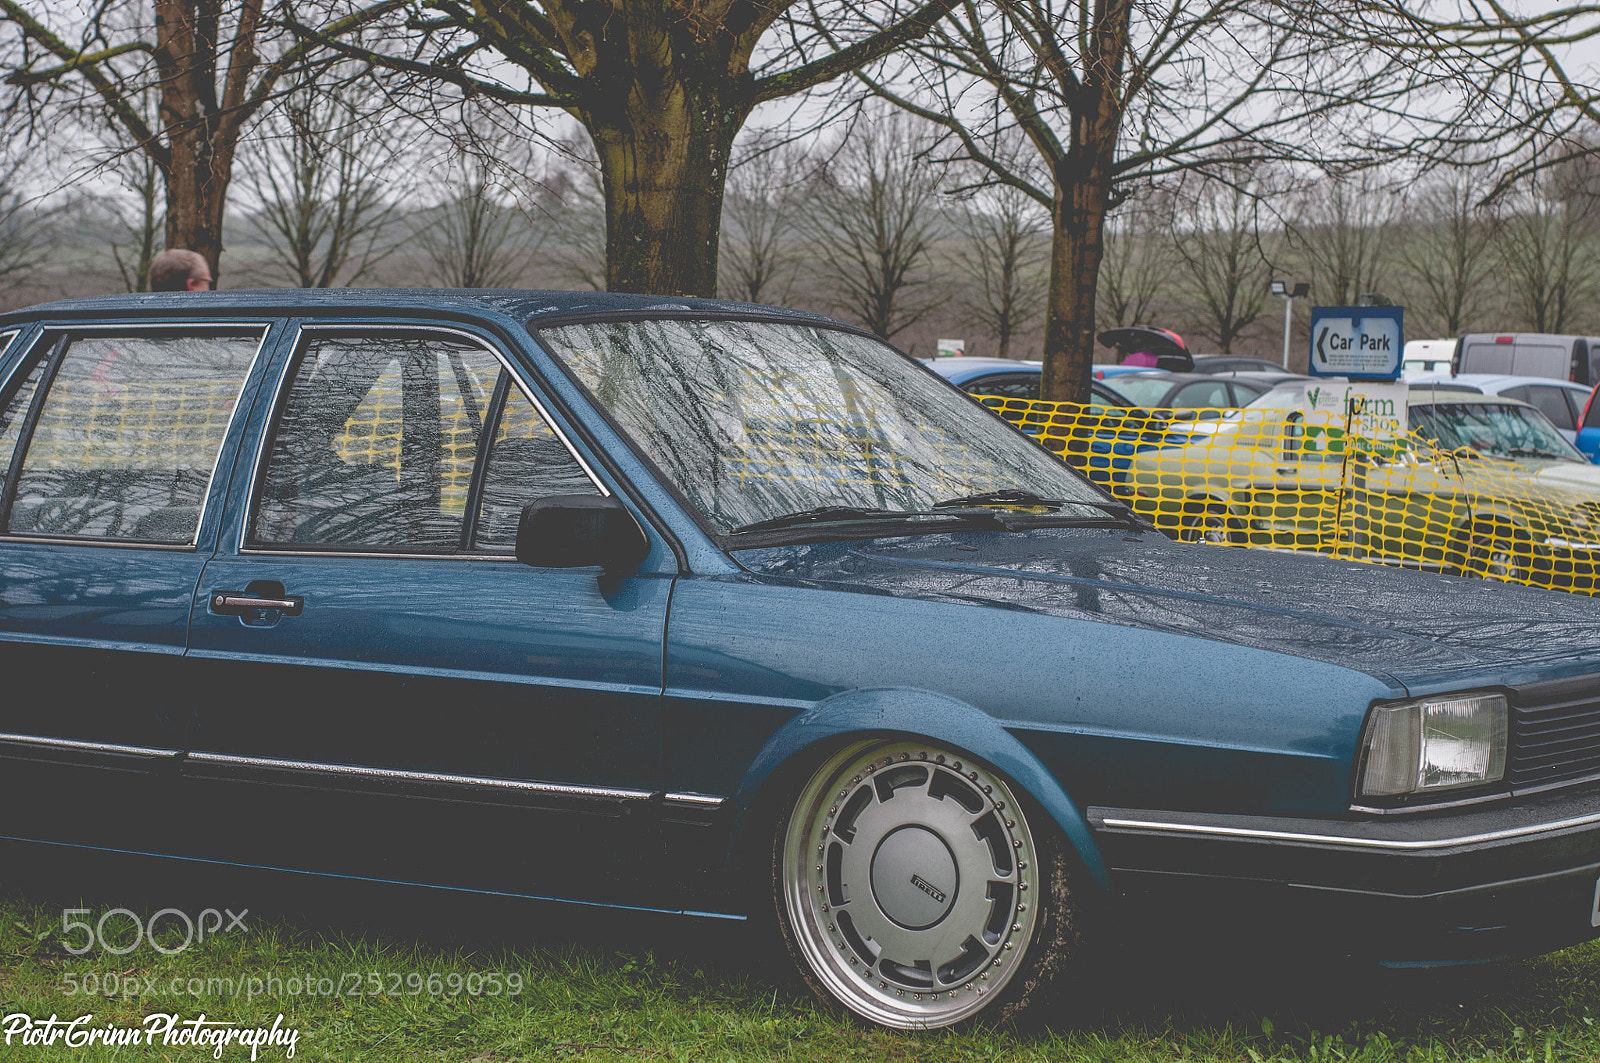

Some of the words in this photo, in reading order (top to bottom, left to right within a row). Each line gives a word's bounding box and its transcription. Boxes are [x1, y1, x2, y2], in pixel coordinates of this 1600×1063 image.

[1329, 333, 1353, 351] Car
[1360, 333, 1391, 351] Park
[910, 873, 946, 903] PIRELLI
